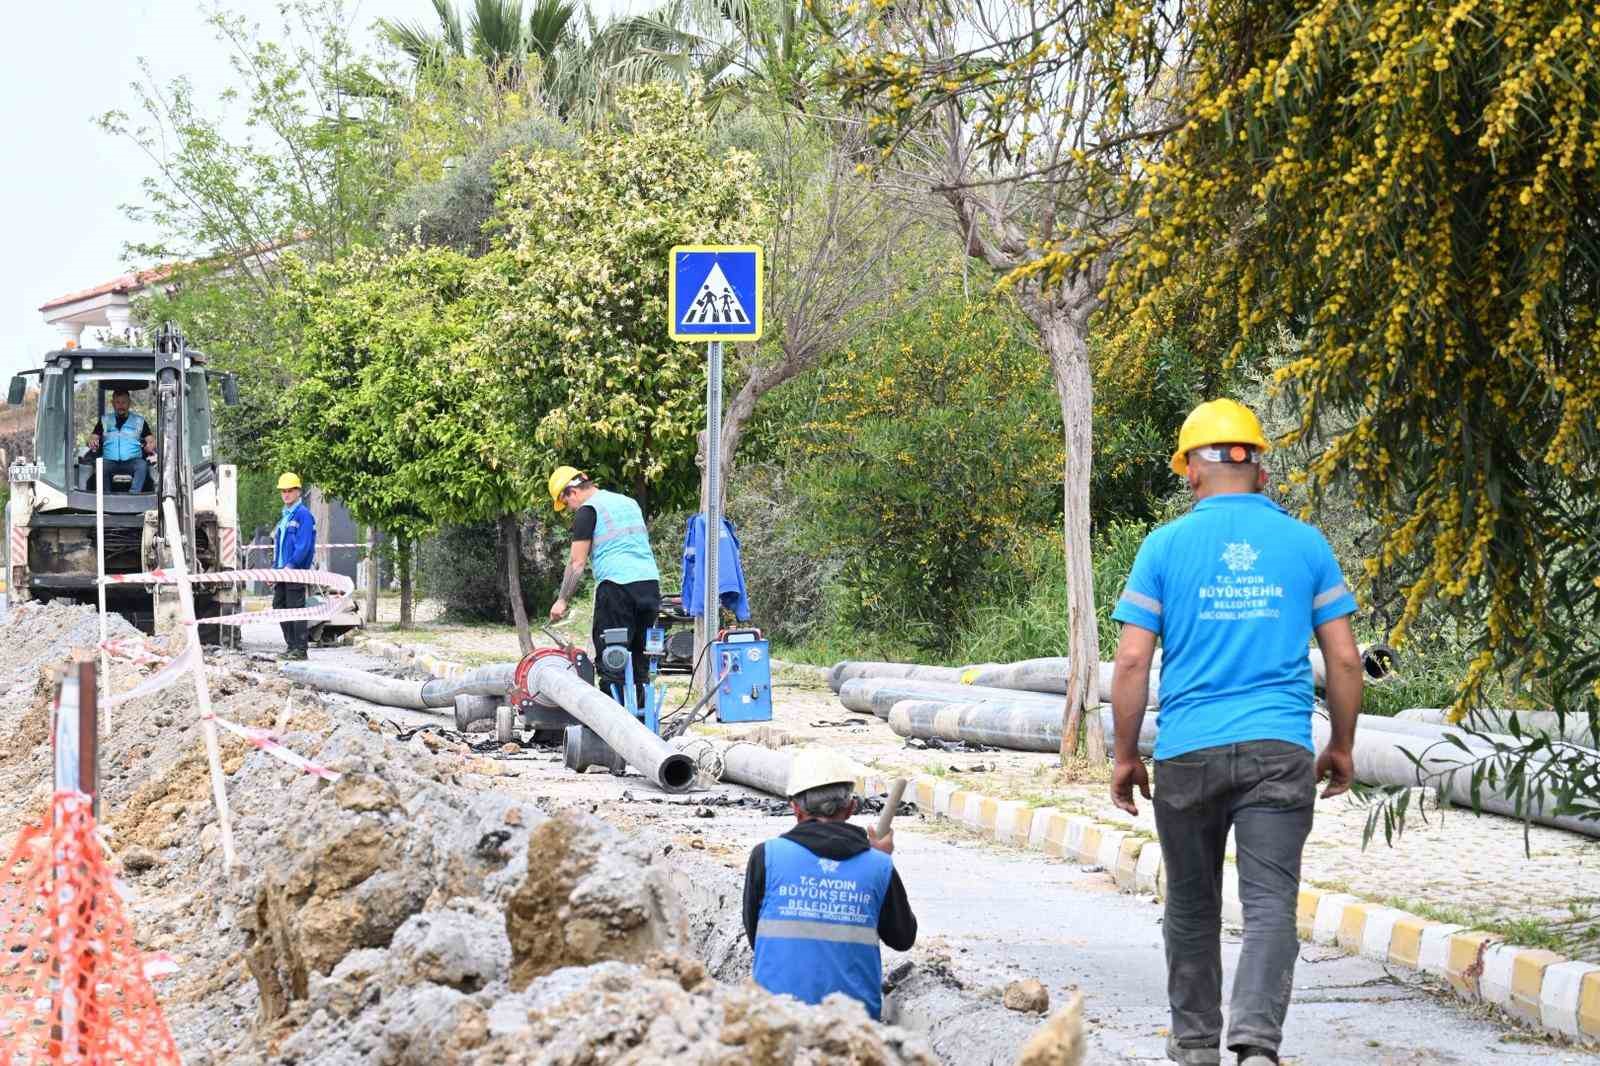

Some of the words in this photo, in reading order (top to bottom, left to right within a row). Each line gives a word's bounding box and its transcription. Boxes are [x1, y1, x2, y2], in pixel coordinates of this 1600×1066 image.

[1216, 575, 1233, 584] T.C.
[1236, 575, 1264, 585] AYDIN
[1199, 584, 1284, 600] BÜYÜKŞEHİR
[800, 875, 818, 887] T.C.
[819, 878, 856, 891] AYDIN
[779, 884, 871, 905] BÜYÜKŞEHİR
